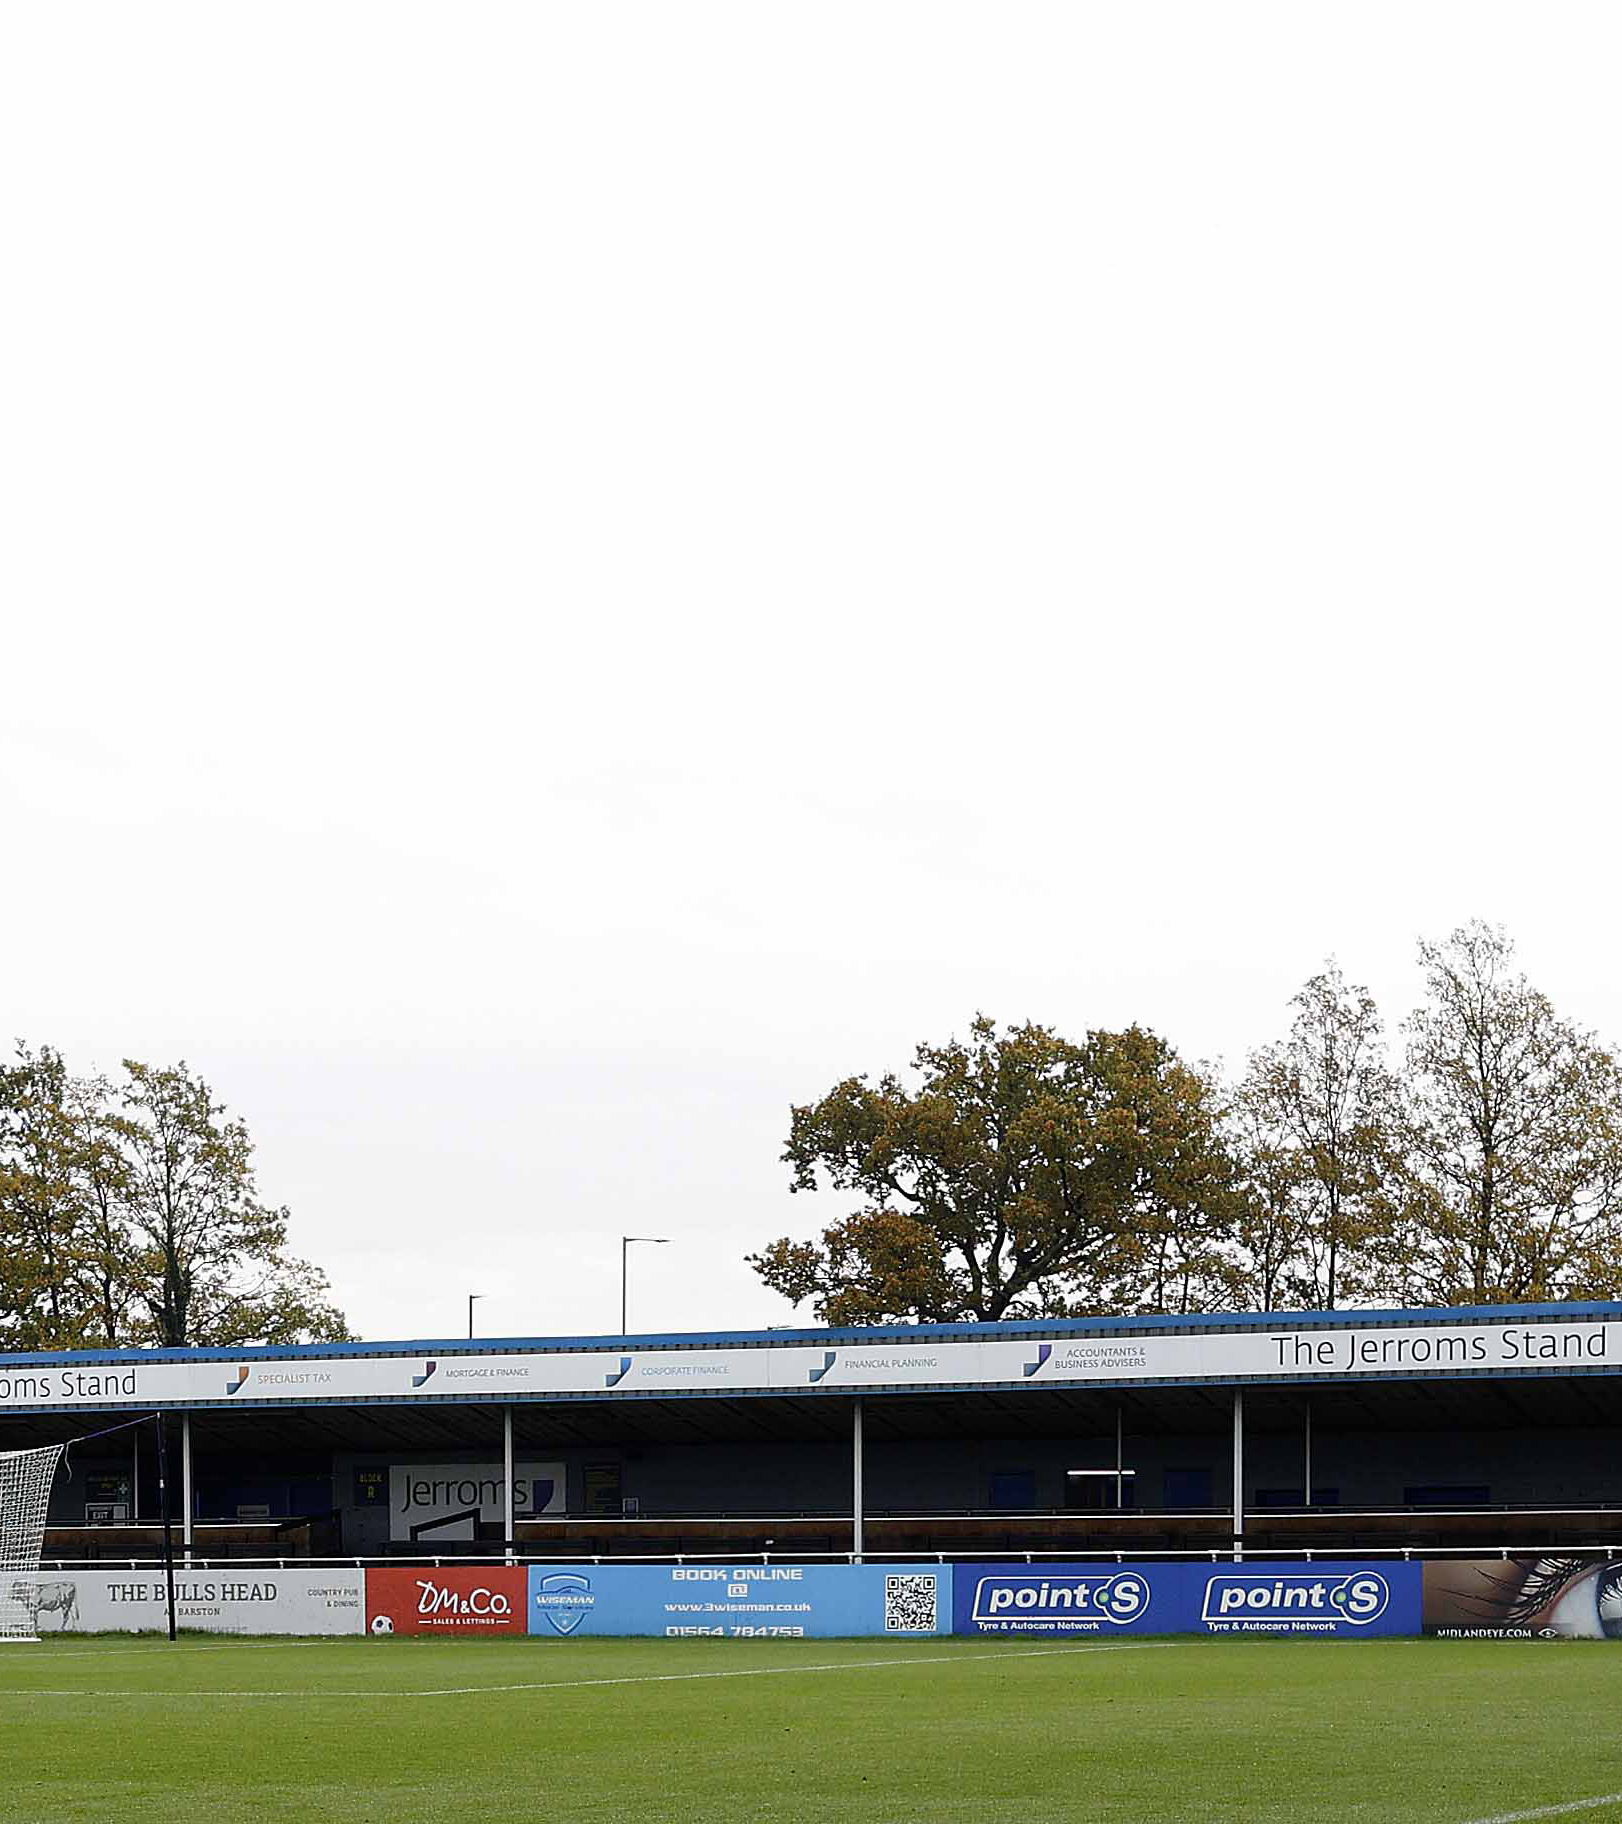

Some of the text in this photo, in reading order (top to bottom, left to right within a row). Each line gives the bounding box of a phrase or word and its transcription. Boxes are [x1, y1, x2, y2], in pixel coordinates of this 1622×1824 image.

[1066, 1347, 1145, 1359] ACCOUNTANTS &
[1271, 1326, 1607, 1370] The Jerroms Stand
[845, 1357, 937, 1369] FINANCIAL PLANNING
[1055, 1357, 1146, 1369] BUSINESS ADVISERS
[445, 1369, 488, 1378] MORTGAGE
[497, 1368, 529, 1377] FINANCE
[641, 1365, 729, 1377] CORPORATE FINANCE
[62, 1369, 137, 1397] Stand
[258, 1373, 331, 1384] SPECIALIST TAX
[401, 1474, 528, 1513] Jerroms
[672, 1569, 803, 1581] BOOK ONLINE
[107, 1584, 148, 1601] THE
[221, 1583, 277, 1600] HEAD
[308, 1588, 359, 1596] COUNTRY PUB
[415, 1580, 512, 1614] DM&Co.
[728, 1584, 748, 1598] @
[989, 1581, 1140, 1613] point S
[1219, 1580, 1379, 1613] point S
[536, 1595, 596, 1605] WISEMAN
[179, 1608, 220, 1616] BARSTON
[664, 1603, 812, 1612] www.3wiseman.co.uk
[978, 1621, 1099, 1630] Tyre & Autocare Network
[1207, 1621, 1336, 1631] Tyre & Autocare Network
[1437, 1628, 1532, 1638] MIDLANDEYE.COM
